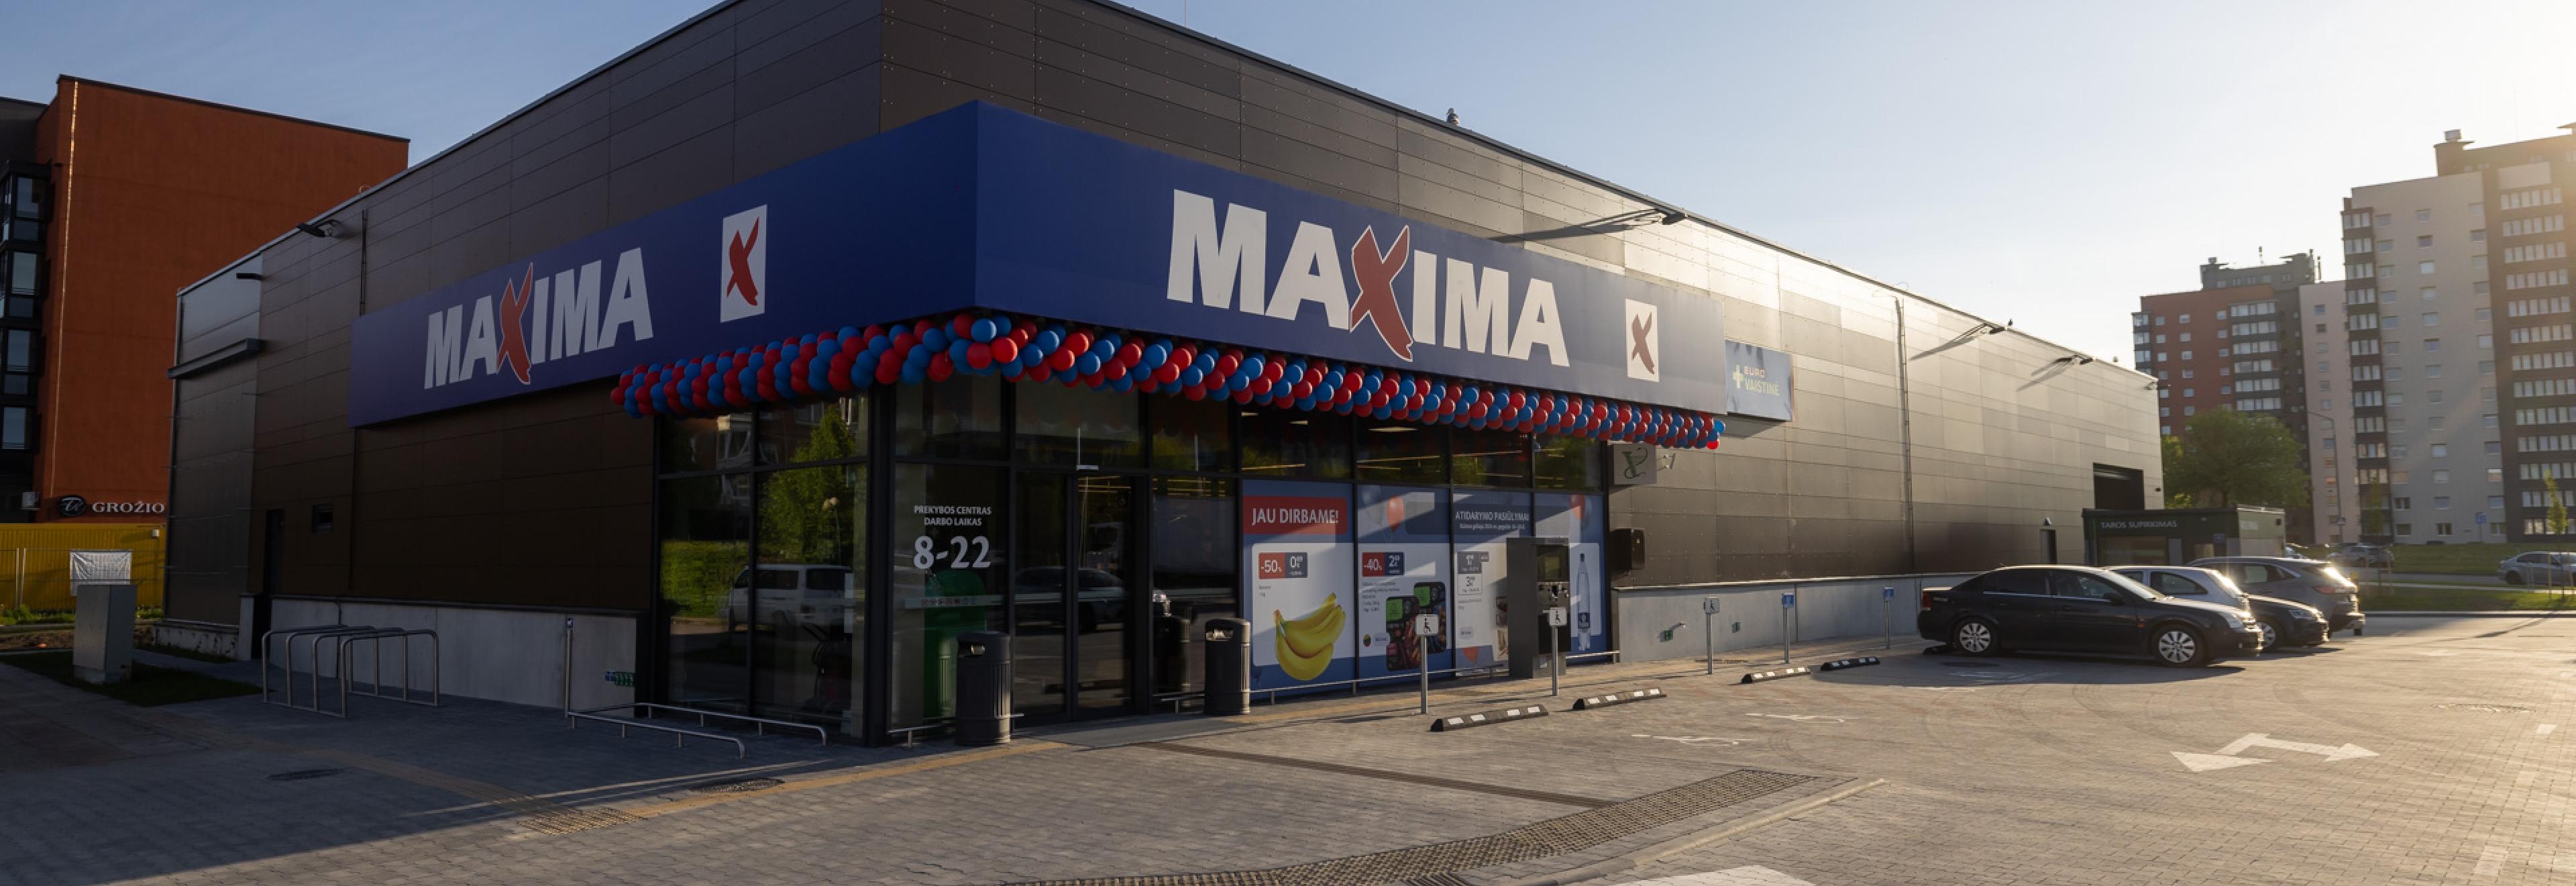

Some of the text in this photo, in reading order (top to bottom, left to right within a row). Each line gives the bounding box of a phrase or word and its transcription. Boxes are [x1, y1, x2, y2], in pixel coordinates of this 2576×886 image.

[1167, 189, 1570, 362] MAXIMA
[424, 248, 653, 389] MAXIMA
[92, 500, 165, 513] GROŽIO
[914, 505, 991, 515] PREKYBOS CENTRAS
[924, 518, 982, 526] DARBO LAIKAS
[1252, 507, 1340, 526] JAU DIRBAME!
[914, 536, 991, 569] 8-22
